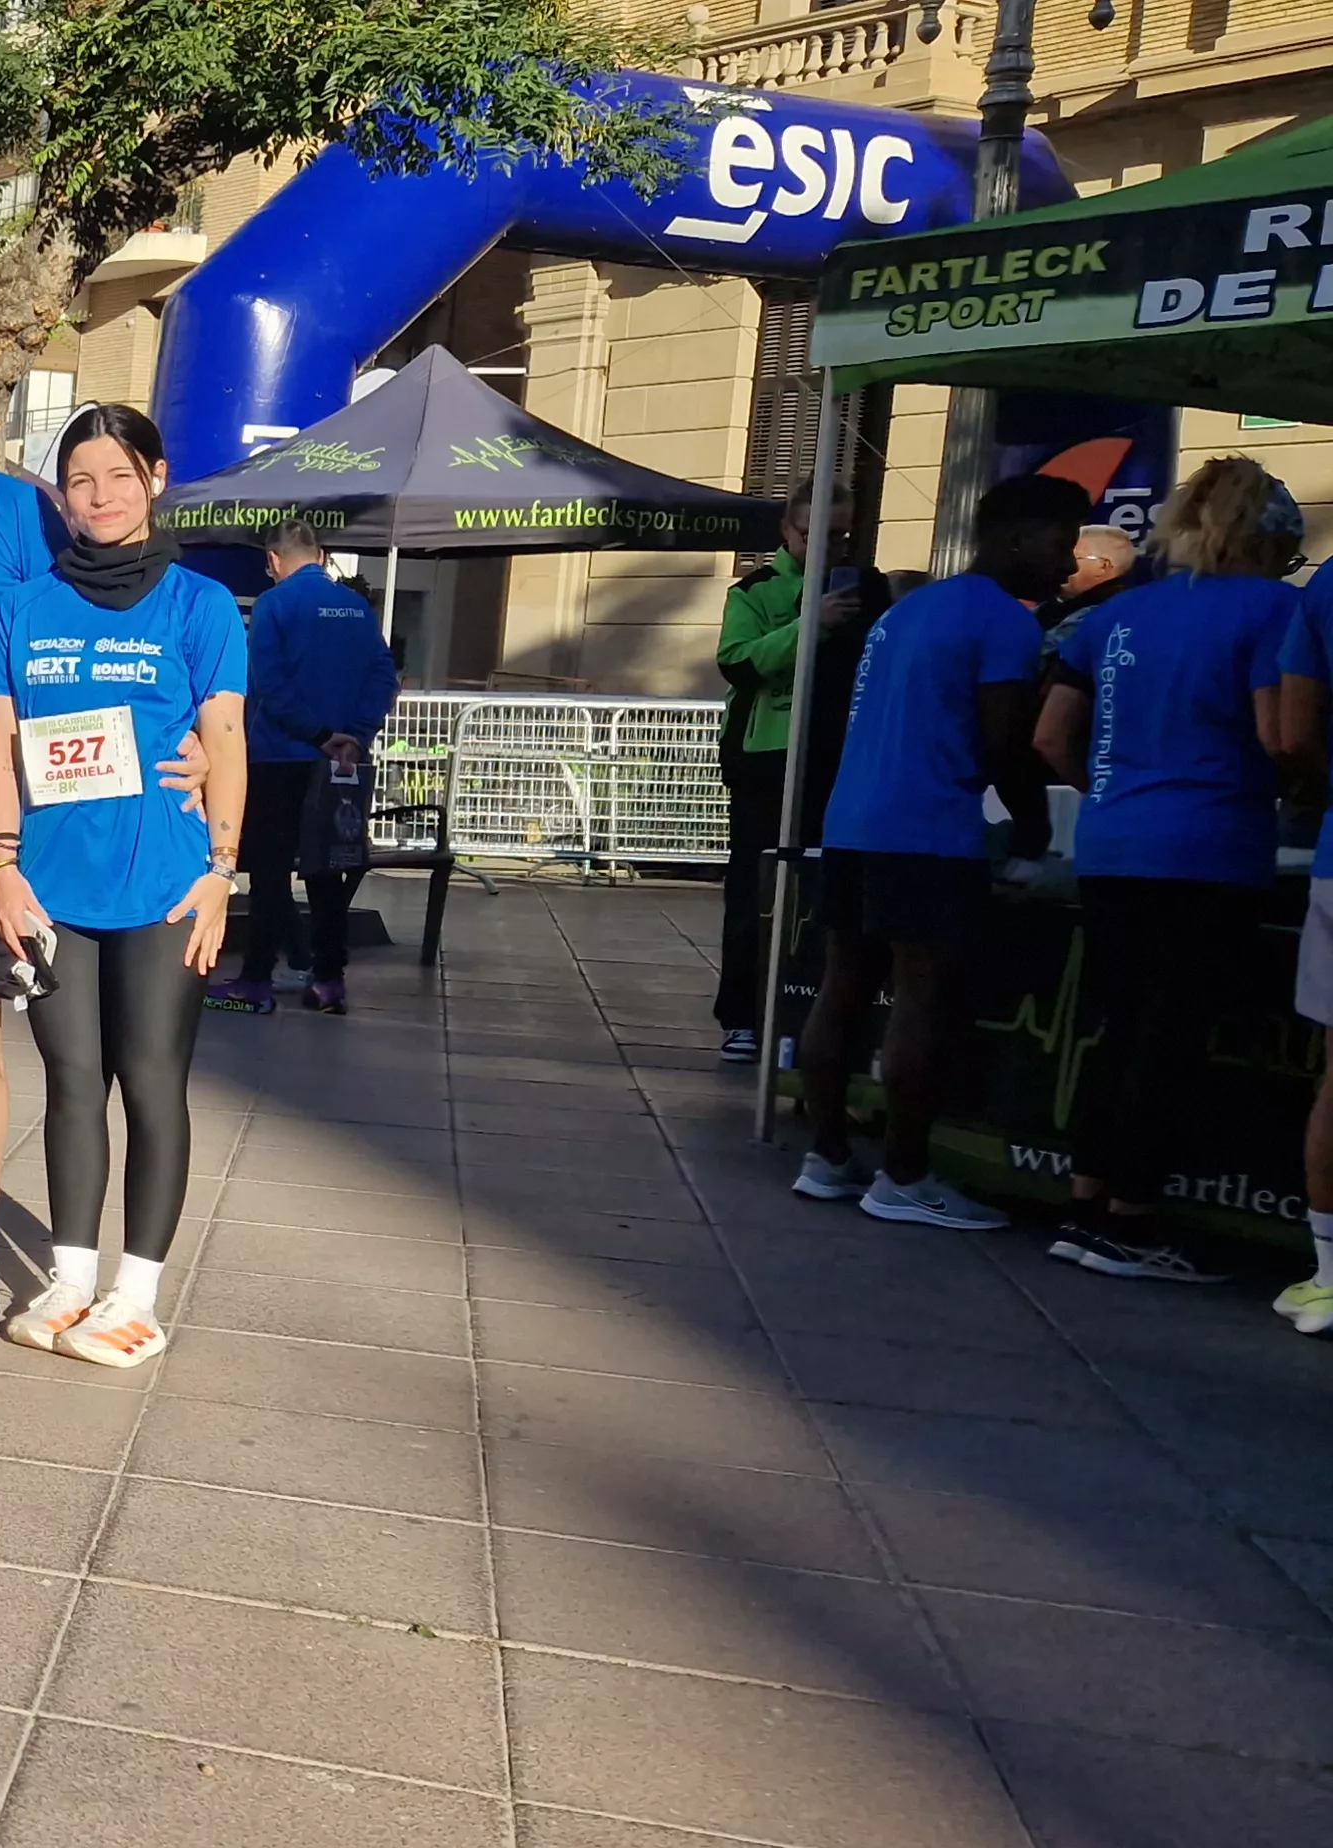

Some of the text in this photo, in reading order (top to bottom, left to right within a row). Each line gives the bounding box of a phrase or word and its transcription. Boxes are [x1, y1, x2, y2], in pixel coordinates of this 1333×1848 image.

[850, 240, 1111, 301] FARTLECK
[1135, 269, 1278, 328] DE
[885, 289, 1056, 337] SPORT
[454, 498, 741, 537] www.fartlecksport.com
[29, 638, 85, 651] MEDIAZION
[110, 637, 162, 656] kablex
[26, 657, 81, 676] NEXT
[92, 663, 136, 675] HOME
[57, 714, 103, 727] CARRERA
[1090, 665, 1117, 803] ecomputer
[49, 736, 105, 766] 527
[45, 764, 114, 781] GABRIELA
[59, 781, 78, 793] 8K
